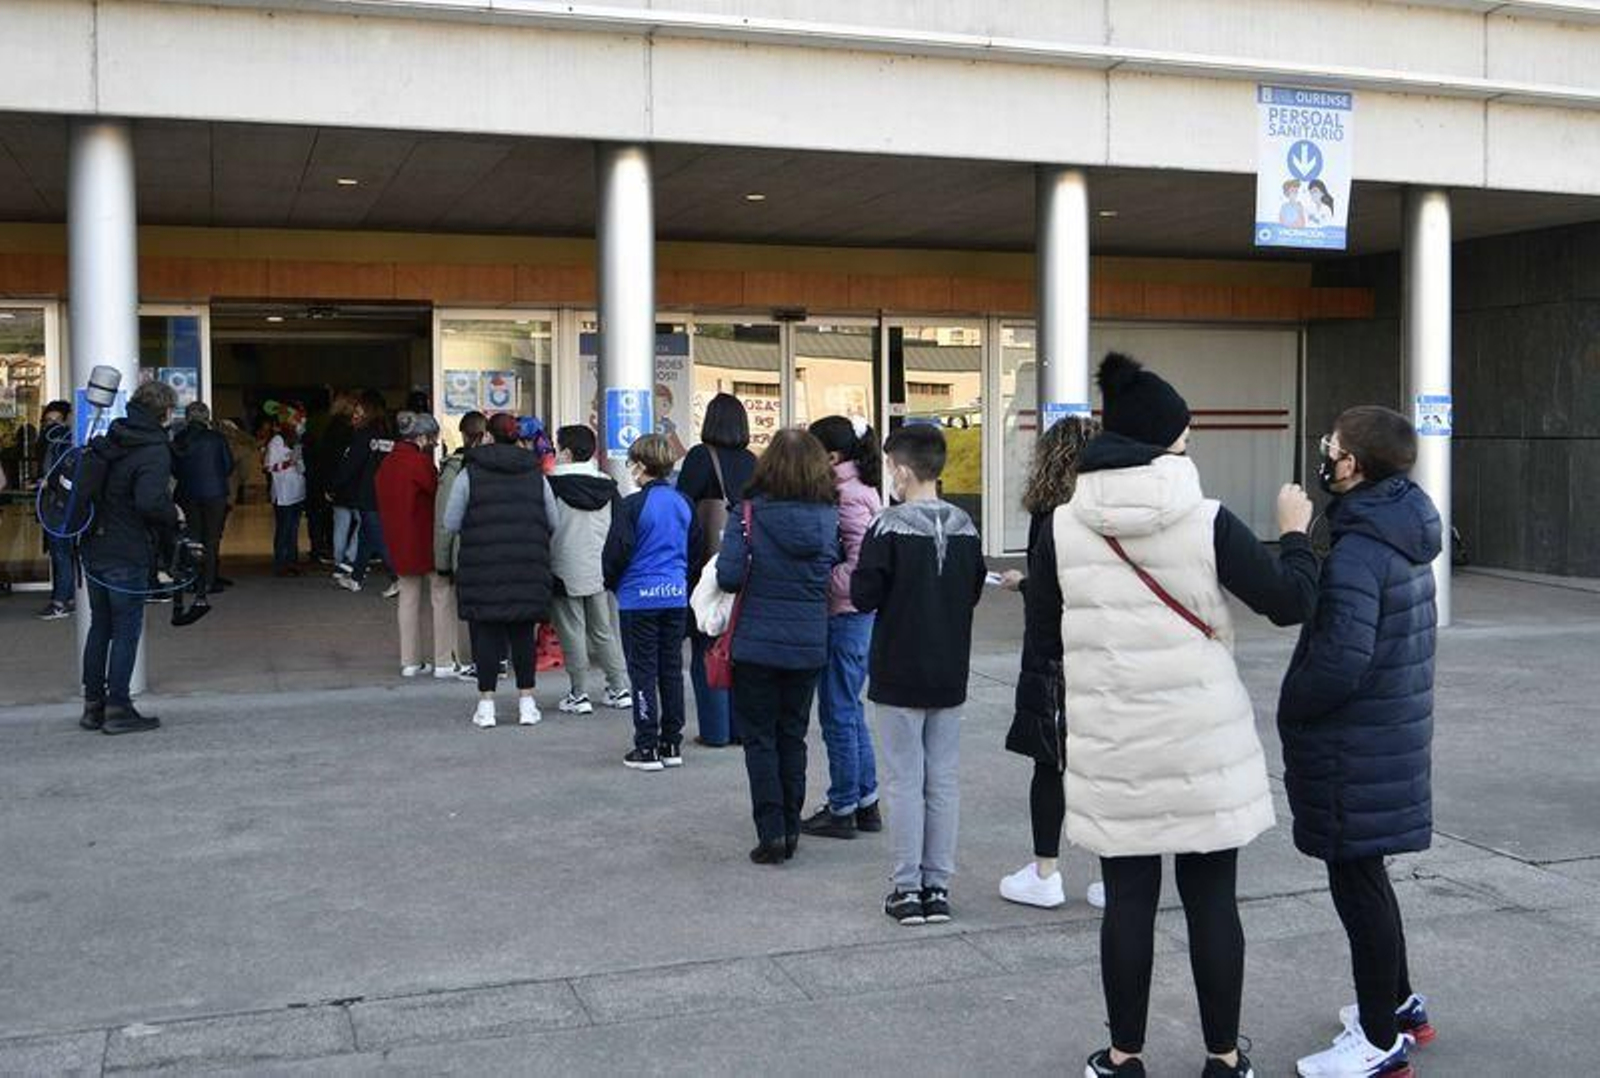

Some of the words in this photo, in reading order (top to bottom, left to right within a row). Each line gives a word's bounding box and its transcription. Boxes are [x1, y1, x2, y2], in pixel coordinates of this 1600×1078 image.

[1295, 91, 1349, 107] OURENSE
[1268, 107, 1344, 128] PERSOAL
[1268, 123, 1345, 141] SANITARIO
[656, 359, 684, 370] ROES
